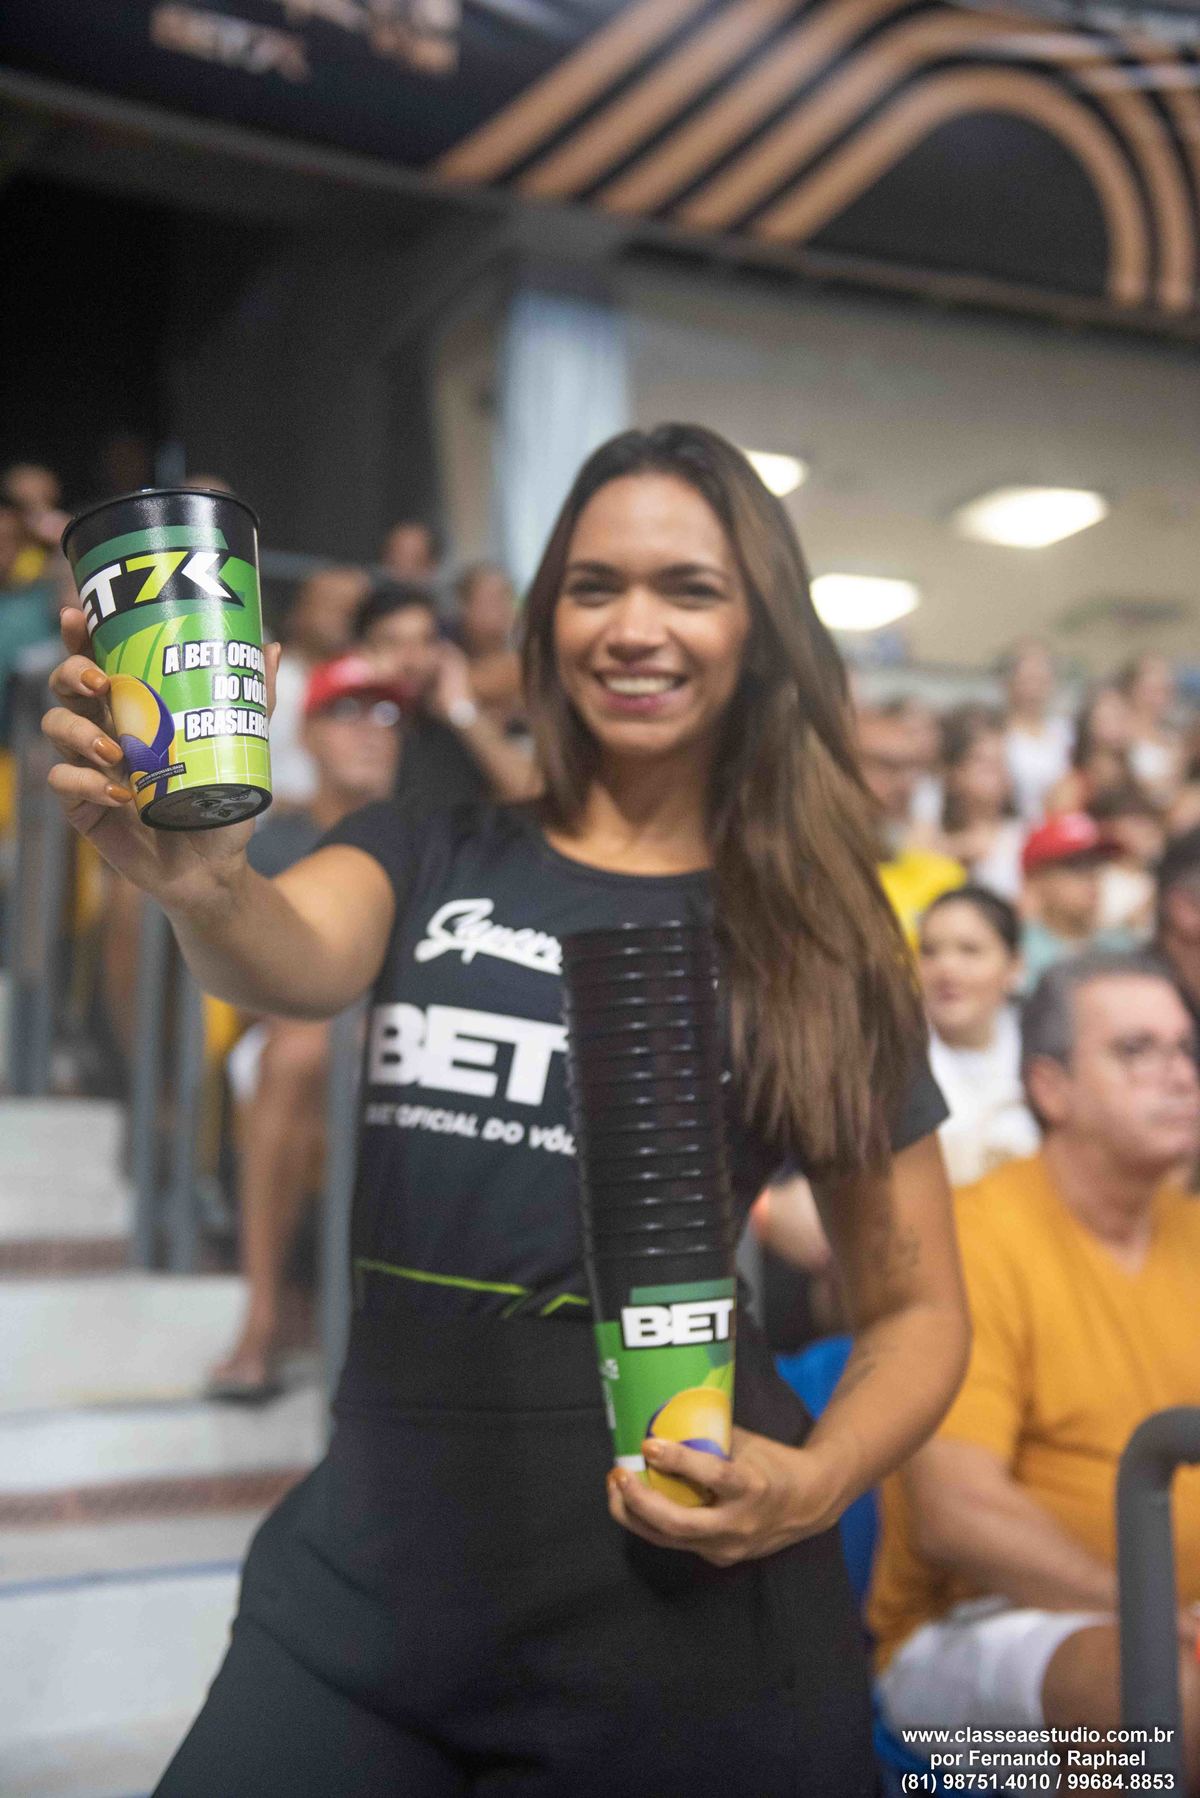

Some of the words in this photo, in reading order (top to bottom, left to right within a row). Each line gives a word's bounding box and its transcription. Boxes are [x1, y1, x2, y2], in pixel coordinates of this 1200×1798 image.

[79, 551, 232, 637] ET7K
[164, 645, 180, 675] A
[184, 641, 224, 670] BET
[213, 673, 240, 701] DO
[368, 1002, 569, 1106] BET
[395, 1104, 479, 1138] OFICIAL
[481, 1117, 525, 1145] DO
[621, 1298, 735, 1349] BET
